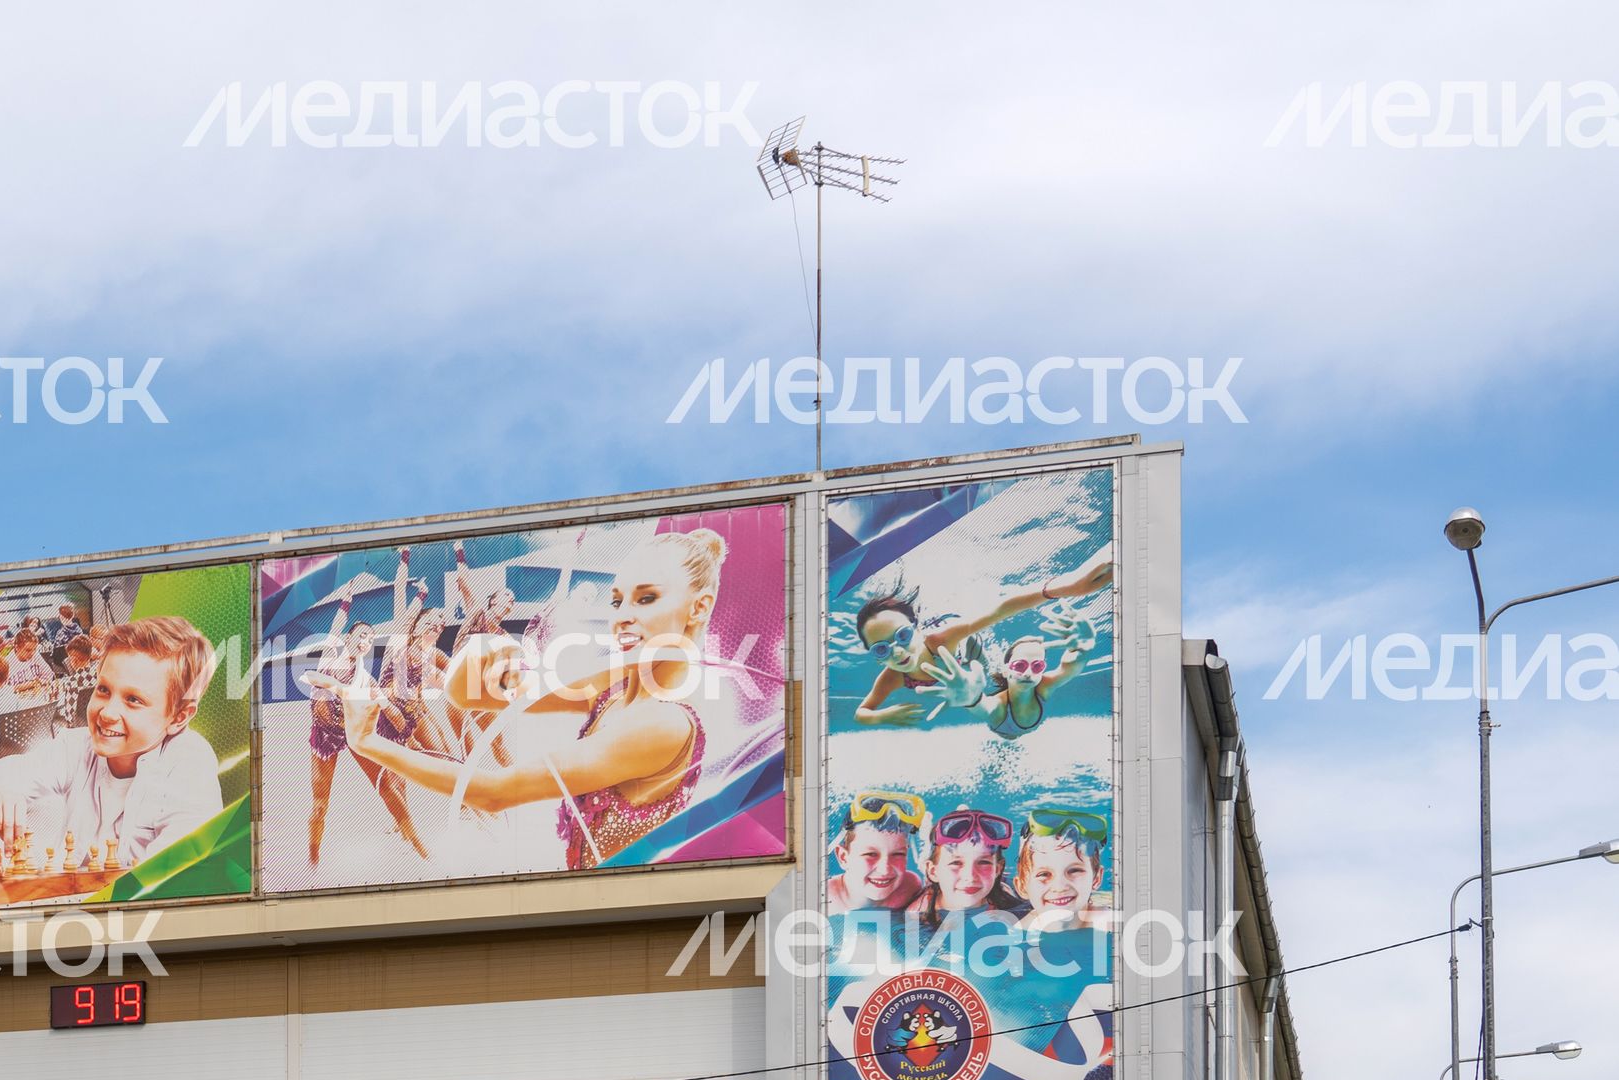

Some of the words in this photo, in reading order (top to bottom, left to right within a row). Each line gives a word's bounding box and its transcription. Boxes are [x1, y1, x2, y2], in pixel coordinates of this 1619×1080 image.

[859, 975, 947, 1037] СПОРТИВНАЯ
[949, 985, 986, 1032] ШКОЛА
[881, 993, 936, 1025] СПОРТИВНАЯ
[938, 997, 964, 1022] ШКОЛА
